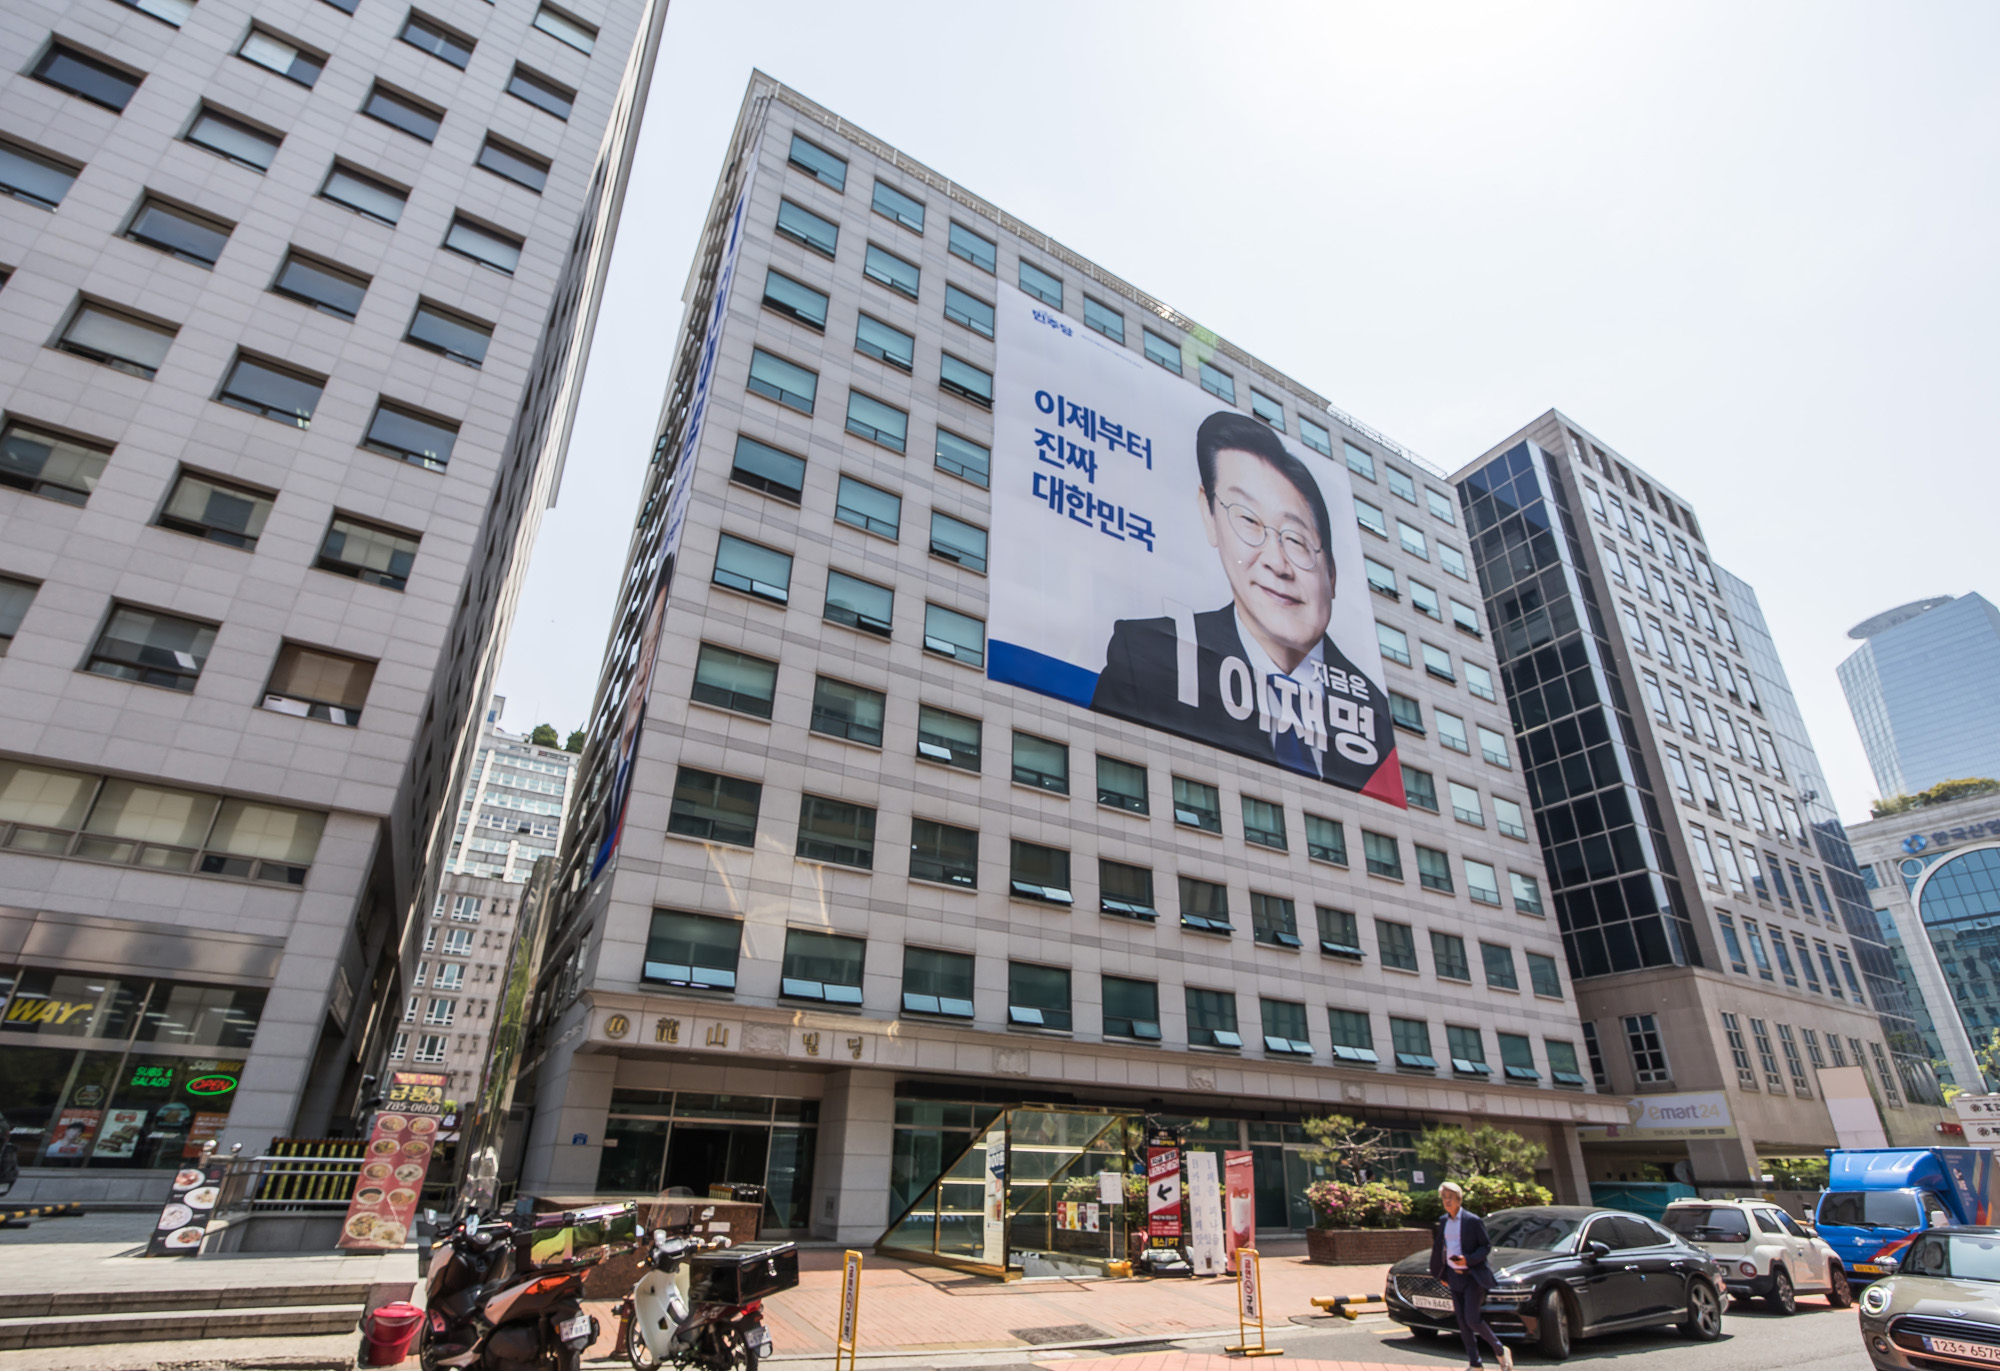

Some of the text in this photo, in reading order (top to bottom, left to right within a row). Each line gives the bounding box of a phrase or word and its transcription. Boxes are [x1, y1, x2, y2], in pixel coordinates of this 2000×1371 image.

[1034, 389, 1152, 470] 이제부터
[1034, 428, 1098, 485] 진짜
[1032, 471, 1156, 553] 대한민국
[1163, 597, 1199, 708] 1
[1310, 659, 1370, 701] 지금은
[1219, 655, 1379, 766] 이재명
[803, 1032, 863, 1060] 빌딩
[136, 1067, 164, 1077] SUBS
[192, 1079, 230, 1091] OPEN
[385, 1101, 440, 1114] 785-0609
[1970, 1345, 2000, 1360] 6578
